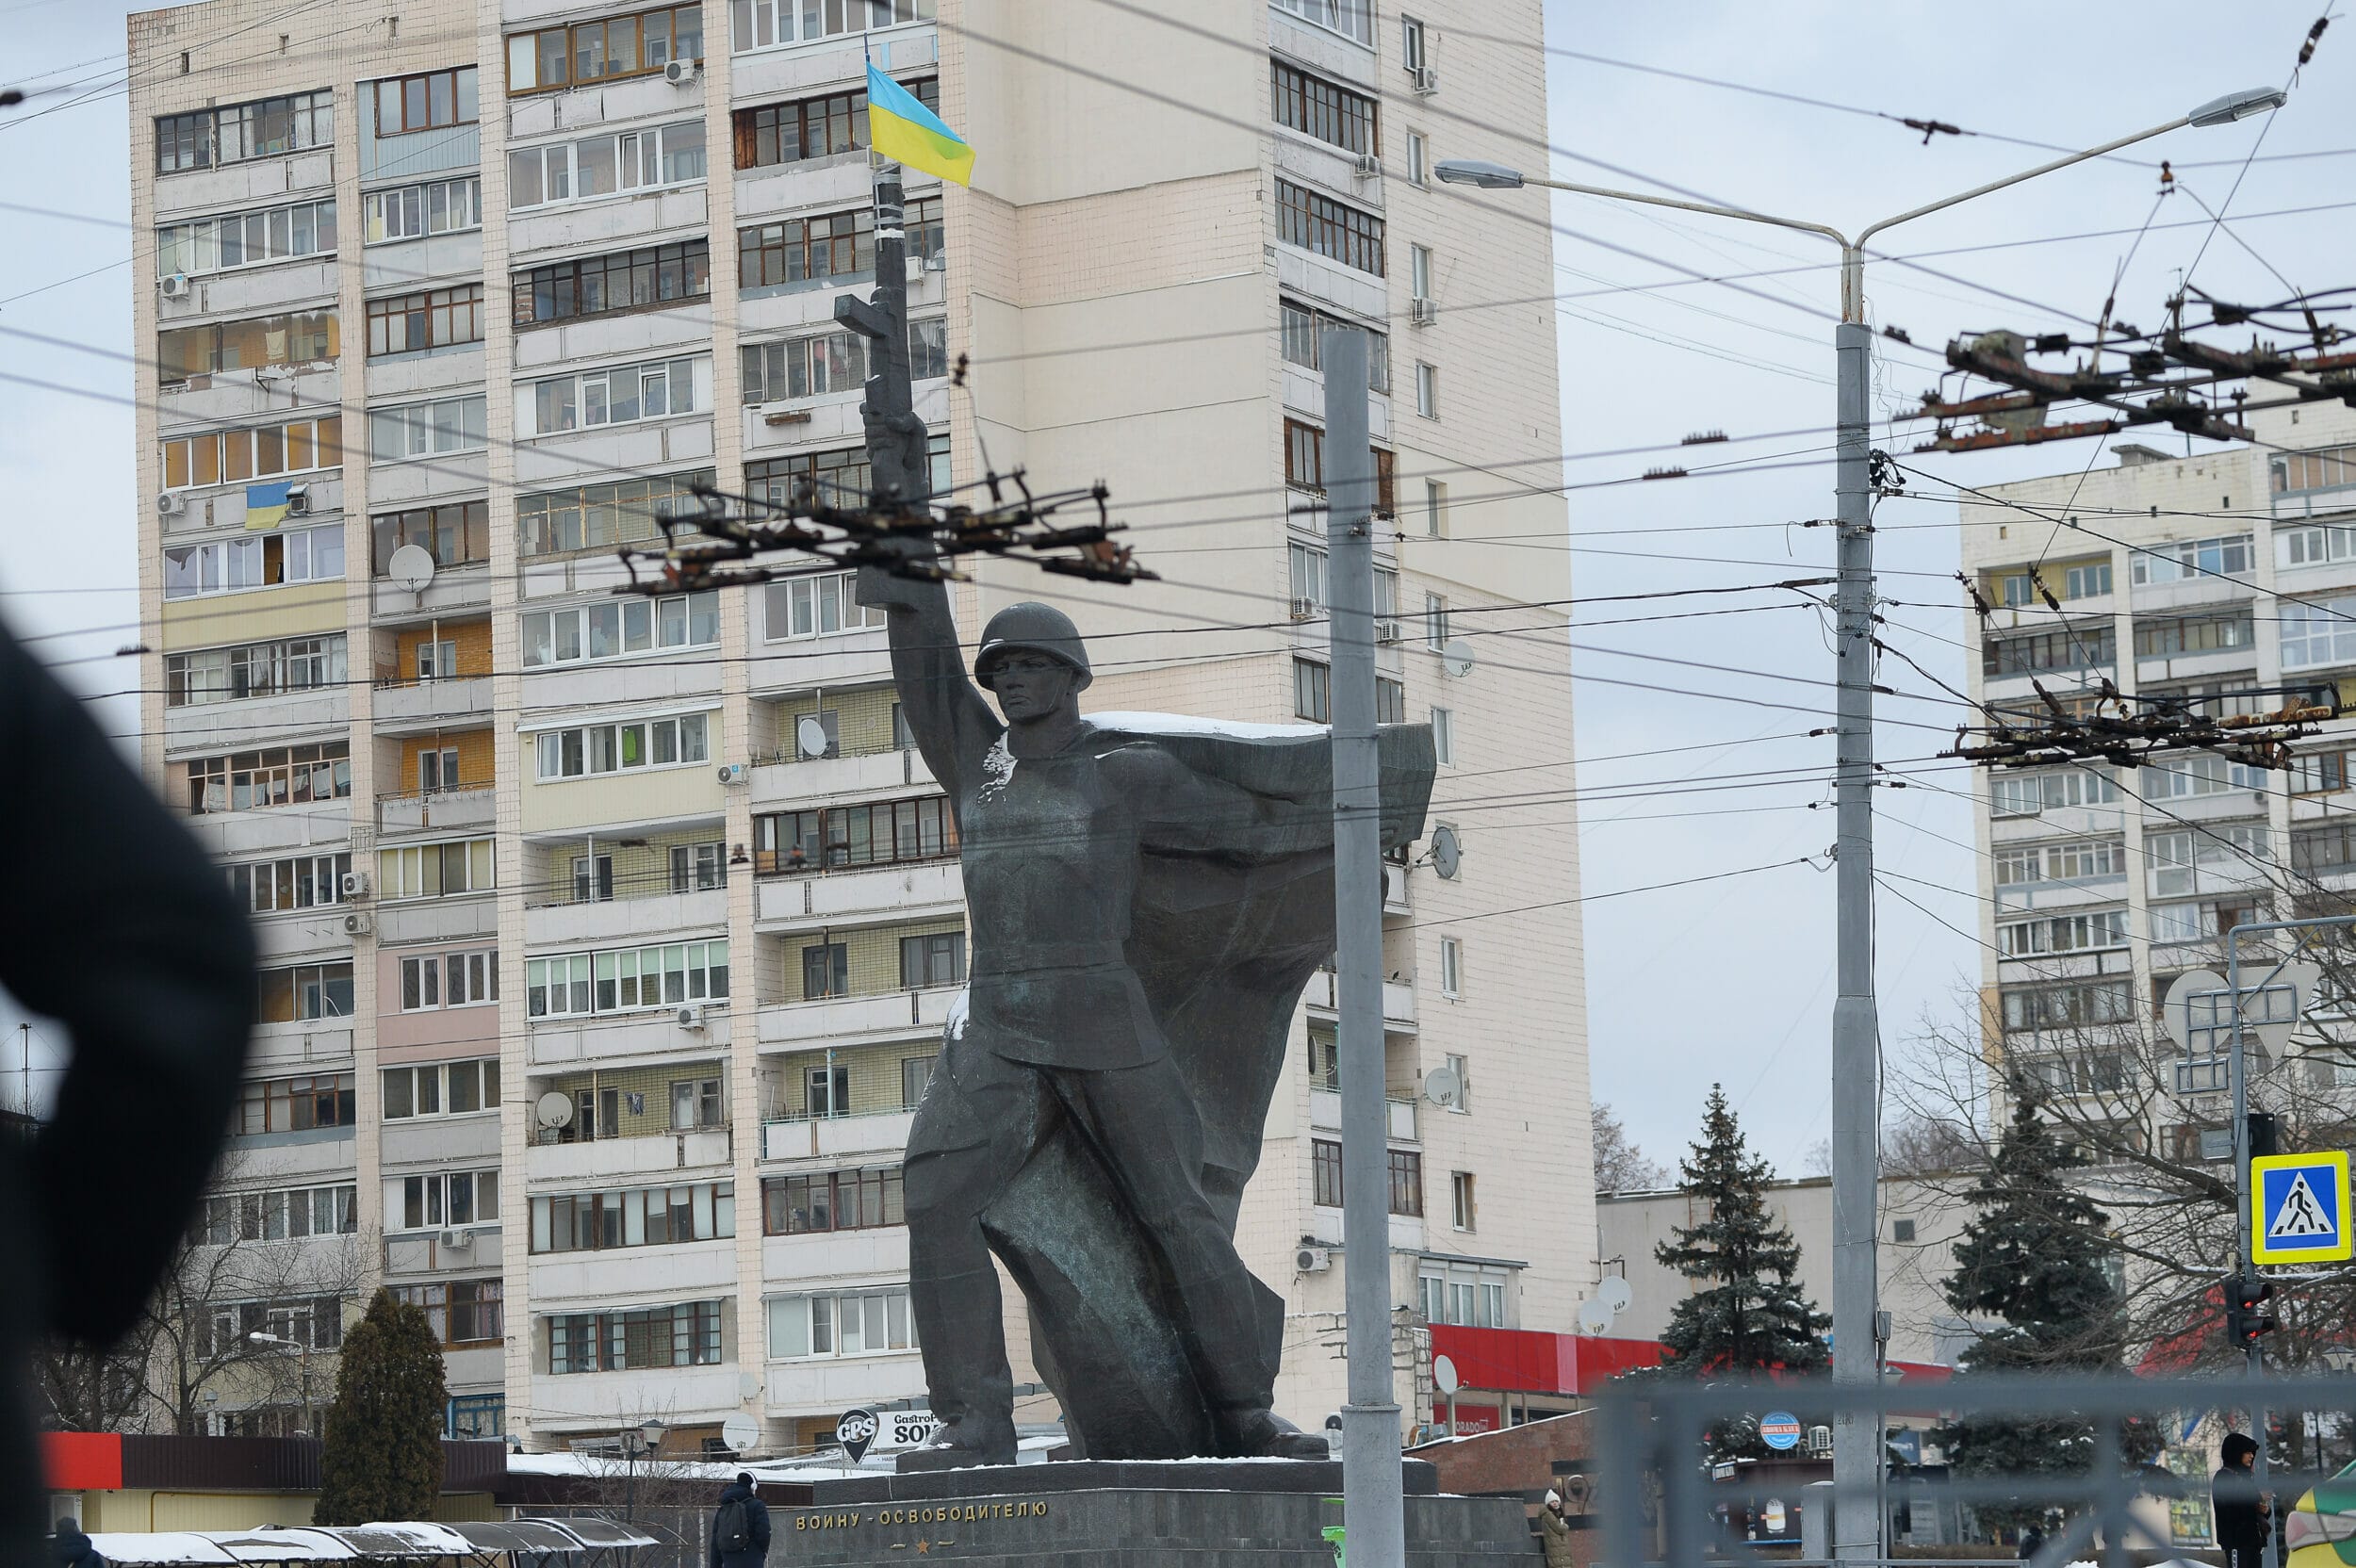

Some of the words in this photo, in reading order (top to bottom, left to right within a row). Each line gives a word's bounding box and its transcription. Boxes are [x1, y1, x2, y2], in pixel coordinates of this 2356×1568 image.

[837, 1418, 875, 1442] GPS
[1455, 1420, 1480, 1432] ORADO
[796, 1512, 860, 1530] ВОИНУ
[879, 1501, 1048, 1525] ОСВОБОДИТЕЛЮ
